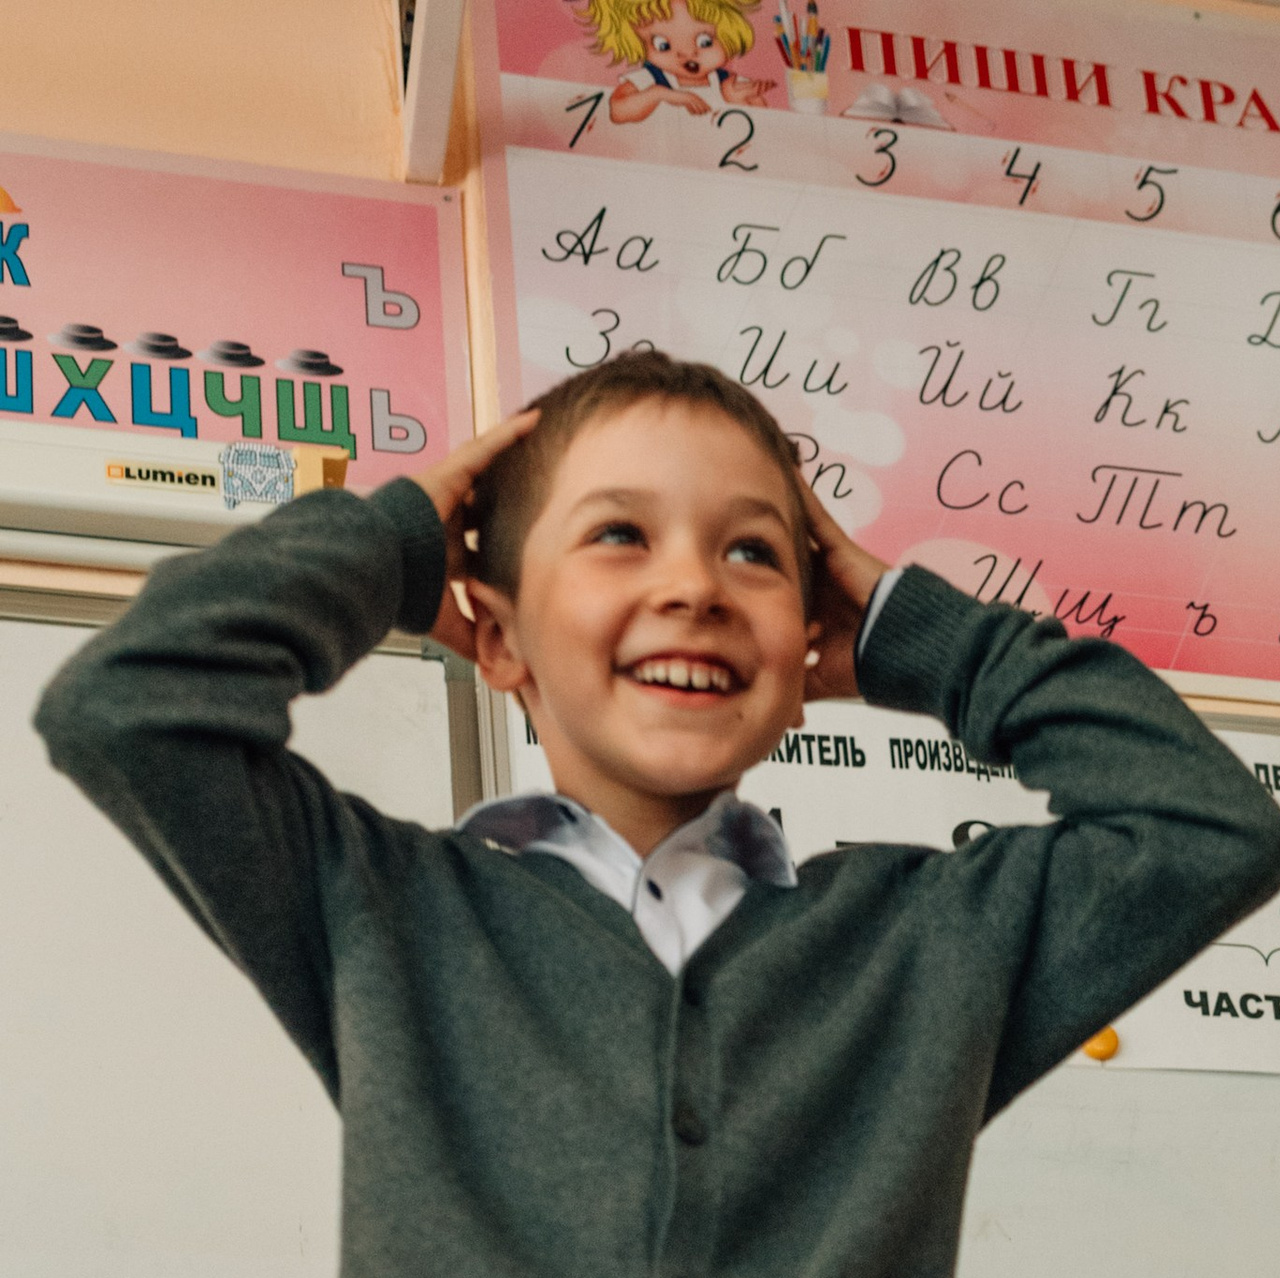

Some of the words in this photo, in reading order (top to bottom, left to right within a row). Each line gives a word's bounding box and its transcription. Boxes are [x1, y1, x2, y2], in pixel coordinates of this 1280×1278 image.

[848, 28, 1113, 107] ПИШИ
[566, 92, 604, 150] 1
[717, 110, 758, 171] 2
[856, 129, 898, 187] 3
[1005, 148, 1041, 206] 4
[1125, 166, 1177, 223] 5
[342, 261, 420, 330] Ъ
[566, 308, 655, 368] З
